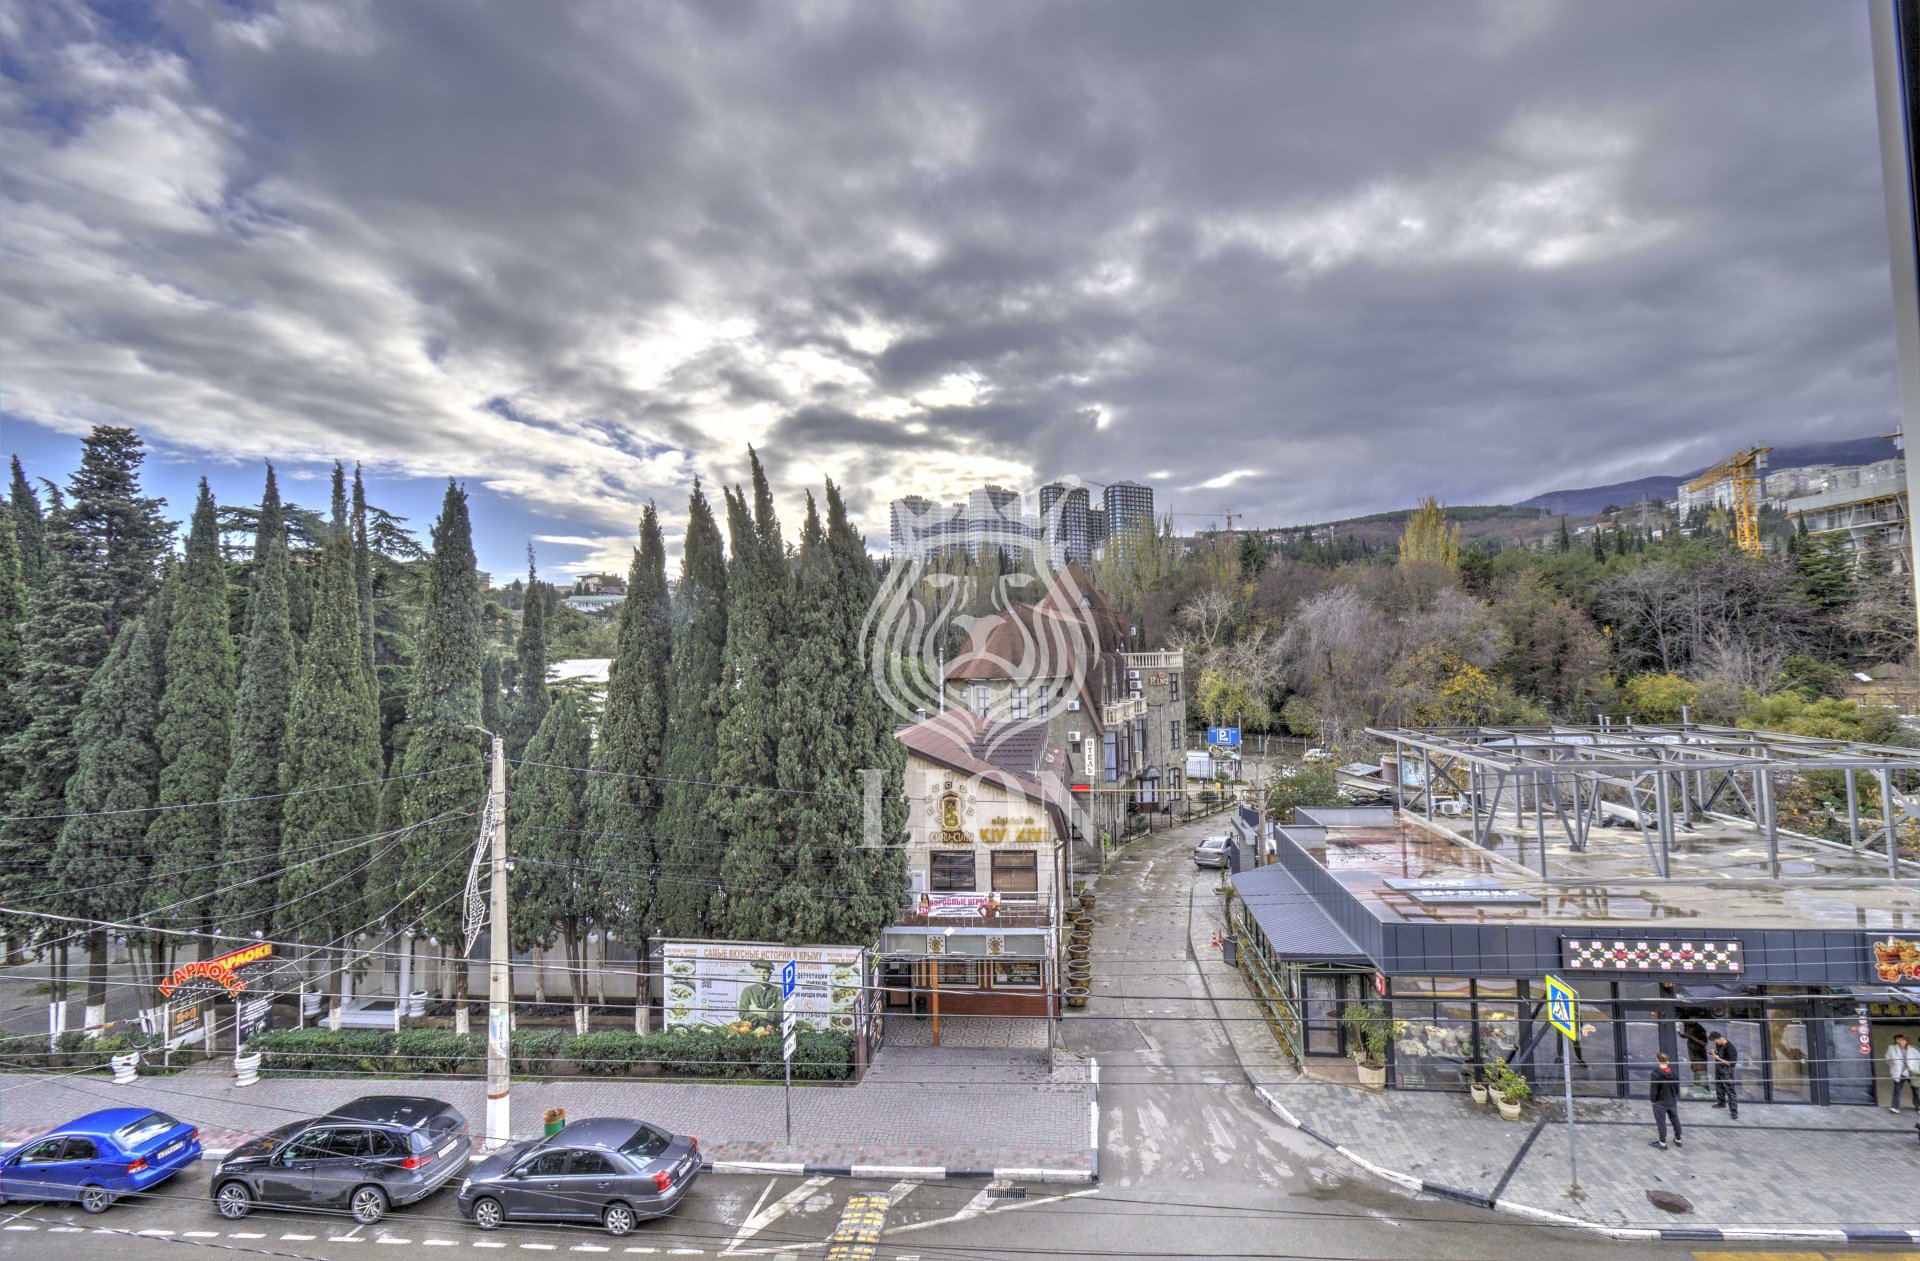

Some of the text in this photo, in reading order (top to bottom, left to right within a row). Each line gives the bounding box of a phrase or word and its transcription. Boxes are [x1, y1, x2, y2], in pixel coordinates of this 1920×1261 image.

[218, 943, 272, 970] АРАОКЕ
[703, 948, 728, 959] САМЫЕ
[728, 949, 760, 960] ВКУСНЫЕ
[760, 950, 792, 960] ИСТОРИИ
[799, 951, 822, 961] КРЫМУ
[158, 961, 248, 998] КАРАОКЕ
